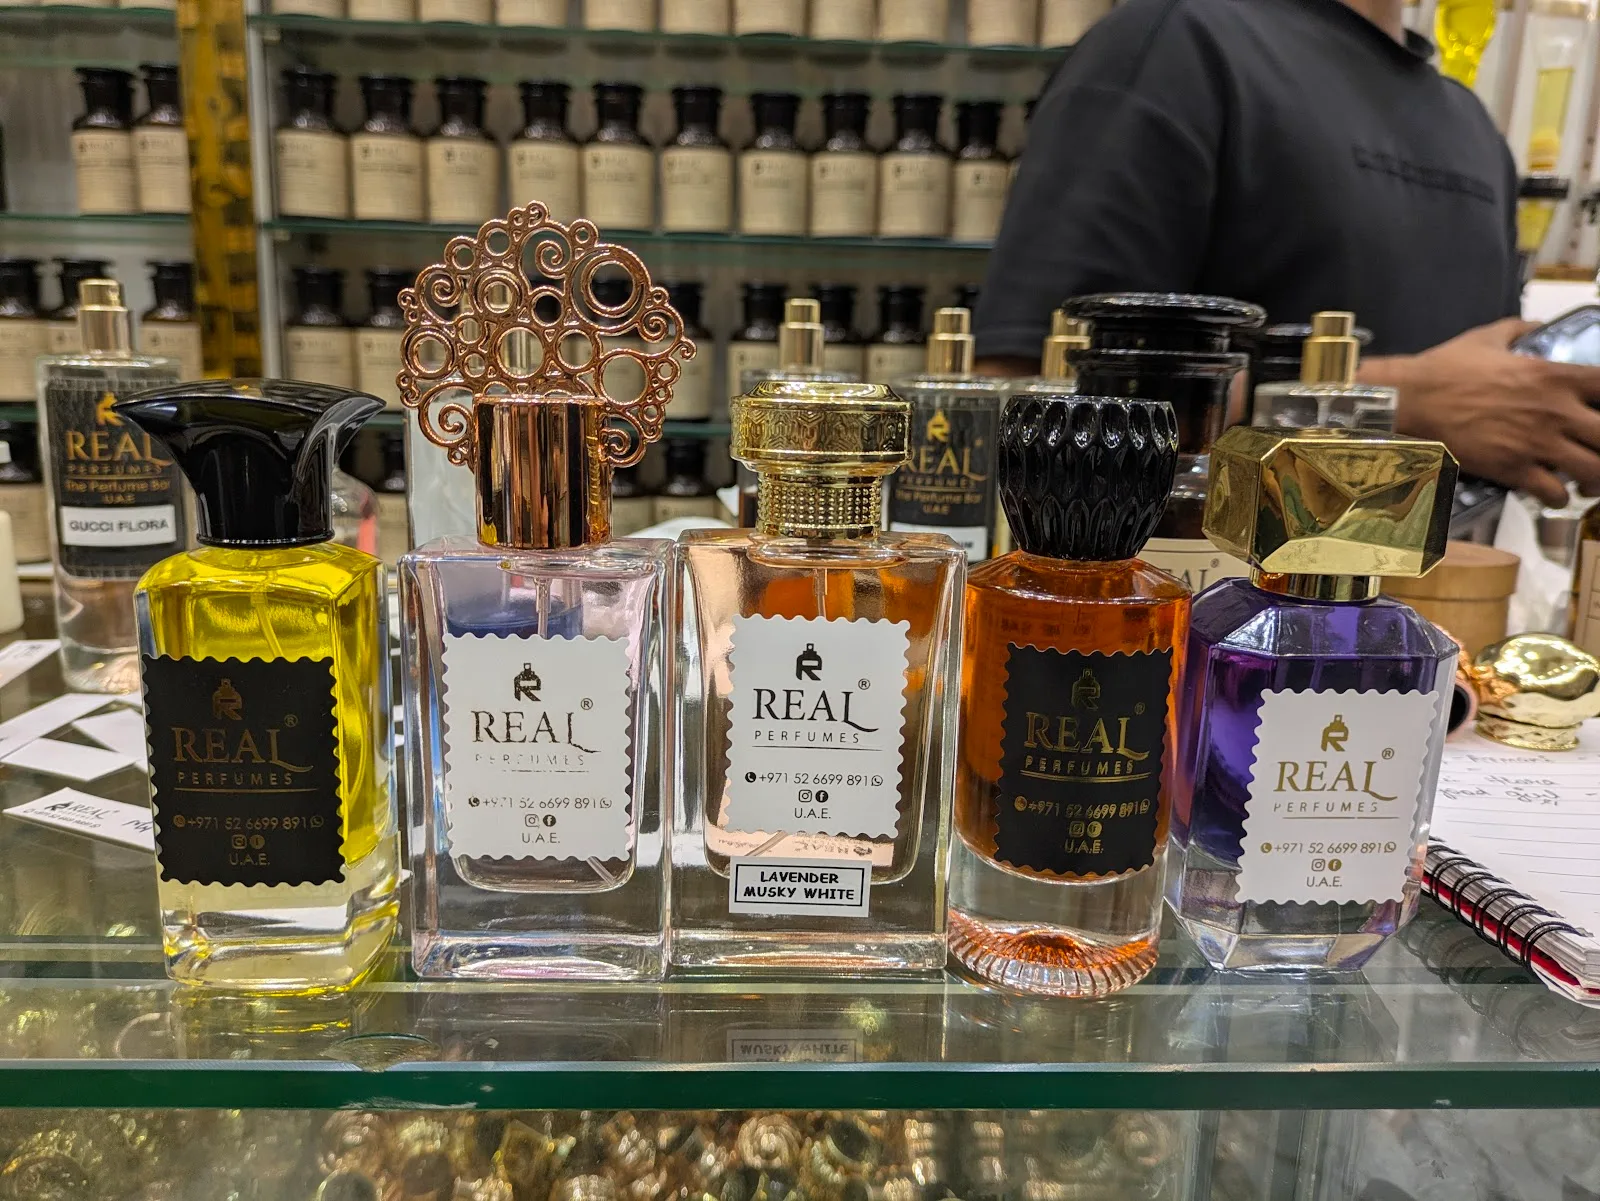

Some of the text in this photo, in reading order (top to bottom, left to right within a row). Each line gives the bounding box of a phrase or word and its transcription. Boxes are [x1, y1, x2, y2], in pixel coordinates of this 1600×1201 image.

[66, 430, 174, 467] REAL
[89, 480, 149, 493] Perfume
[69, 519, 169, 533] GUCCI FLORA
[752, 688, 880, 733] REAL
[471, 710, 602, 753] REAL
[754, 730, 860, 744] PERFUMES
[1024, 711, 1150, 761] REAL
[171, 727, 313, 773] REAL
[1024, 755, 1135, 776] PERFUMES
[177, 772, 294, 786] PERFUMES
[758, 772, 868, 787] +971 52 6699 891
[1273, 760, 1398, 802] REAL
[519, 797, 534, 809] 52
[539, 797, 570, 809] 6699
[574, 797, 597, 809] 891
[1273, 801, 1379, 813] PERFUMES
[68, 803, 105, 820] REAL
[794, 807, 832, 819] U.A.E.
[1028, 801, 1141, 820] +971 52 6699 891
[187, 816, 307, 830] +971 52 6699 891
[521, 832, 561, 844] U.A.E.
[1064, 838, 1104, 855] U.A.E.
[1274, 842, 1382, 855] +971 52 6699 891
[228, 852, 271, 866] U.A.E.
[760, 870, 840, 884] LAVENDER
[1306, 876, 1343, 888] U.A.E.
[743, 886, 855, 900] MUSKY WHITE
